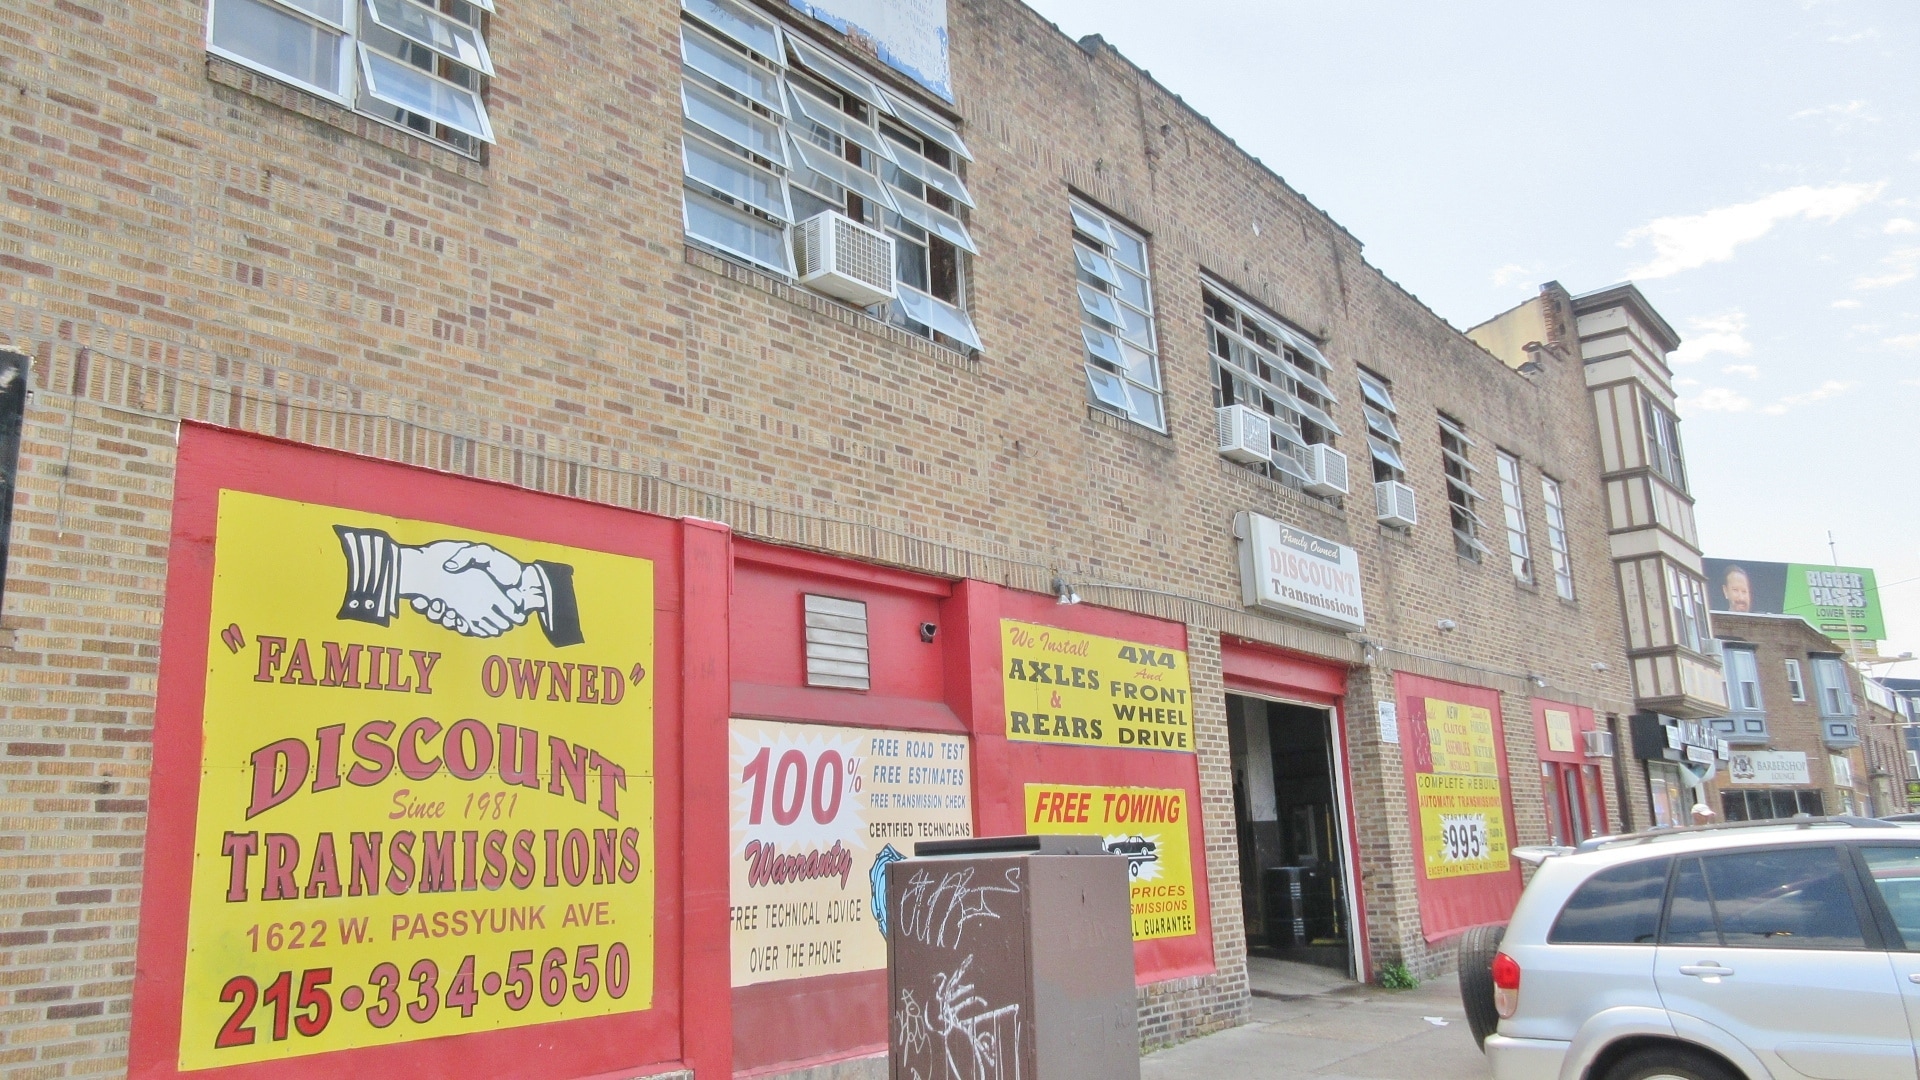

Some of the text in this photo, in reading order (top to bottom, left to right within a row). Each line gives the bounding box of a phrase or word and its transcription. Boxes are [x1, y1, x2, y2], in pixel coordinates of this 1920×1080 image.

[1281, 528, 1338, 559] Family Owned
[1268, 546, 1355, 597] DISCOUNT
[1806, 570, 1863, 589] BIGGER
[1272, 578, 1359, 618] Transmissions
[1810, 587, 1866, 608] CASES
[1010, 627, 1090, 658] We Install
[1009, 658, 1100, 690] AXLES
[1133, 668, 1163, 681] And
[1050, 690, 1062, 708] &
[1110, 681, 1187, 704] FRONT
[1113, 704, 1187, 726] WHEEL
[1446, 705, 1459, 720] NEW
[1011, 711, 1103, 740] REARS
[1443, 722, 1467, 735] CLUTCH
[1118, 728, 1187, 748] DRIVE
[871, 738, 965, 761] FREE ROAD TEST
[245, 717, 627, 821] DISCOUNT
[873, 765, 964, 785] FREE ESTIMATES
[1418, 776, 1498, 790] COMPLETE REBUILT
[388, 788, 519, 822] Since 1981
[870, 793, 966, 809] FREE TRANSMISSION CHECK
[1034, 792, 1180, 823] FREE TOWING
[1420, 795, 1455, 808] AUTOMATIC
[1443, 813, 1472, 821] STARTING
[870, 822, 970, 838] CERTIFIED TECHNICIANS
[221, 827, 640, 902] TRANSMISSIONS
[745, 839, 852, 890] Warranty
[1132, 885, 1185, 898] PRICES
[730, 899, 861, 931] FREE TECHNICAL ADVICE
[1130, 900, 1188, 915] SMISSIONS
[246, 901, 616, 953] 1622 W. PASSYUNK AVE.
[1144, 915, 1191, 936] GUARANTEE
[750, 940, 841, 973] OVER THE PHONE
